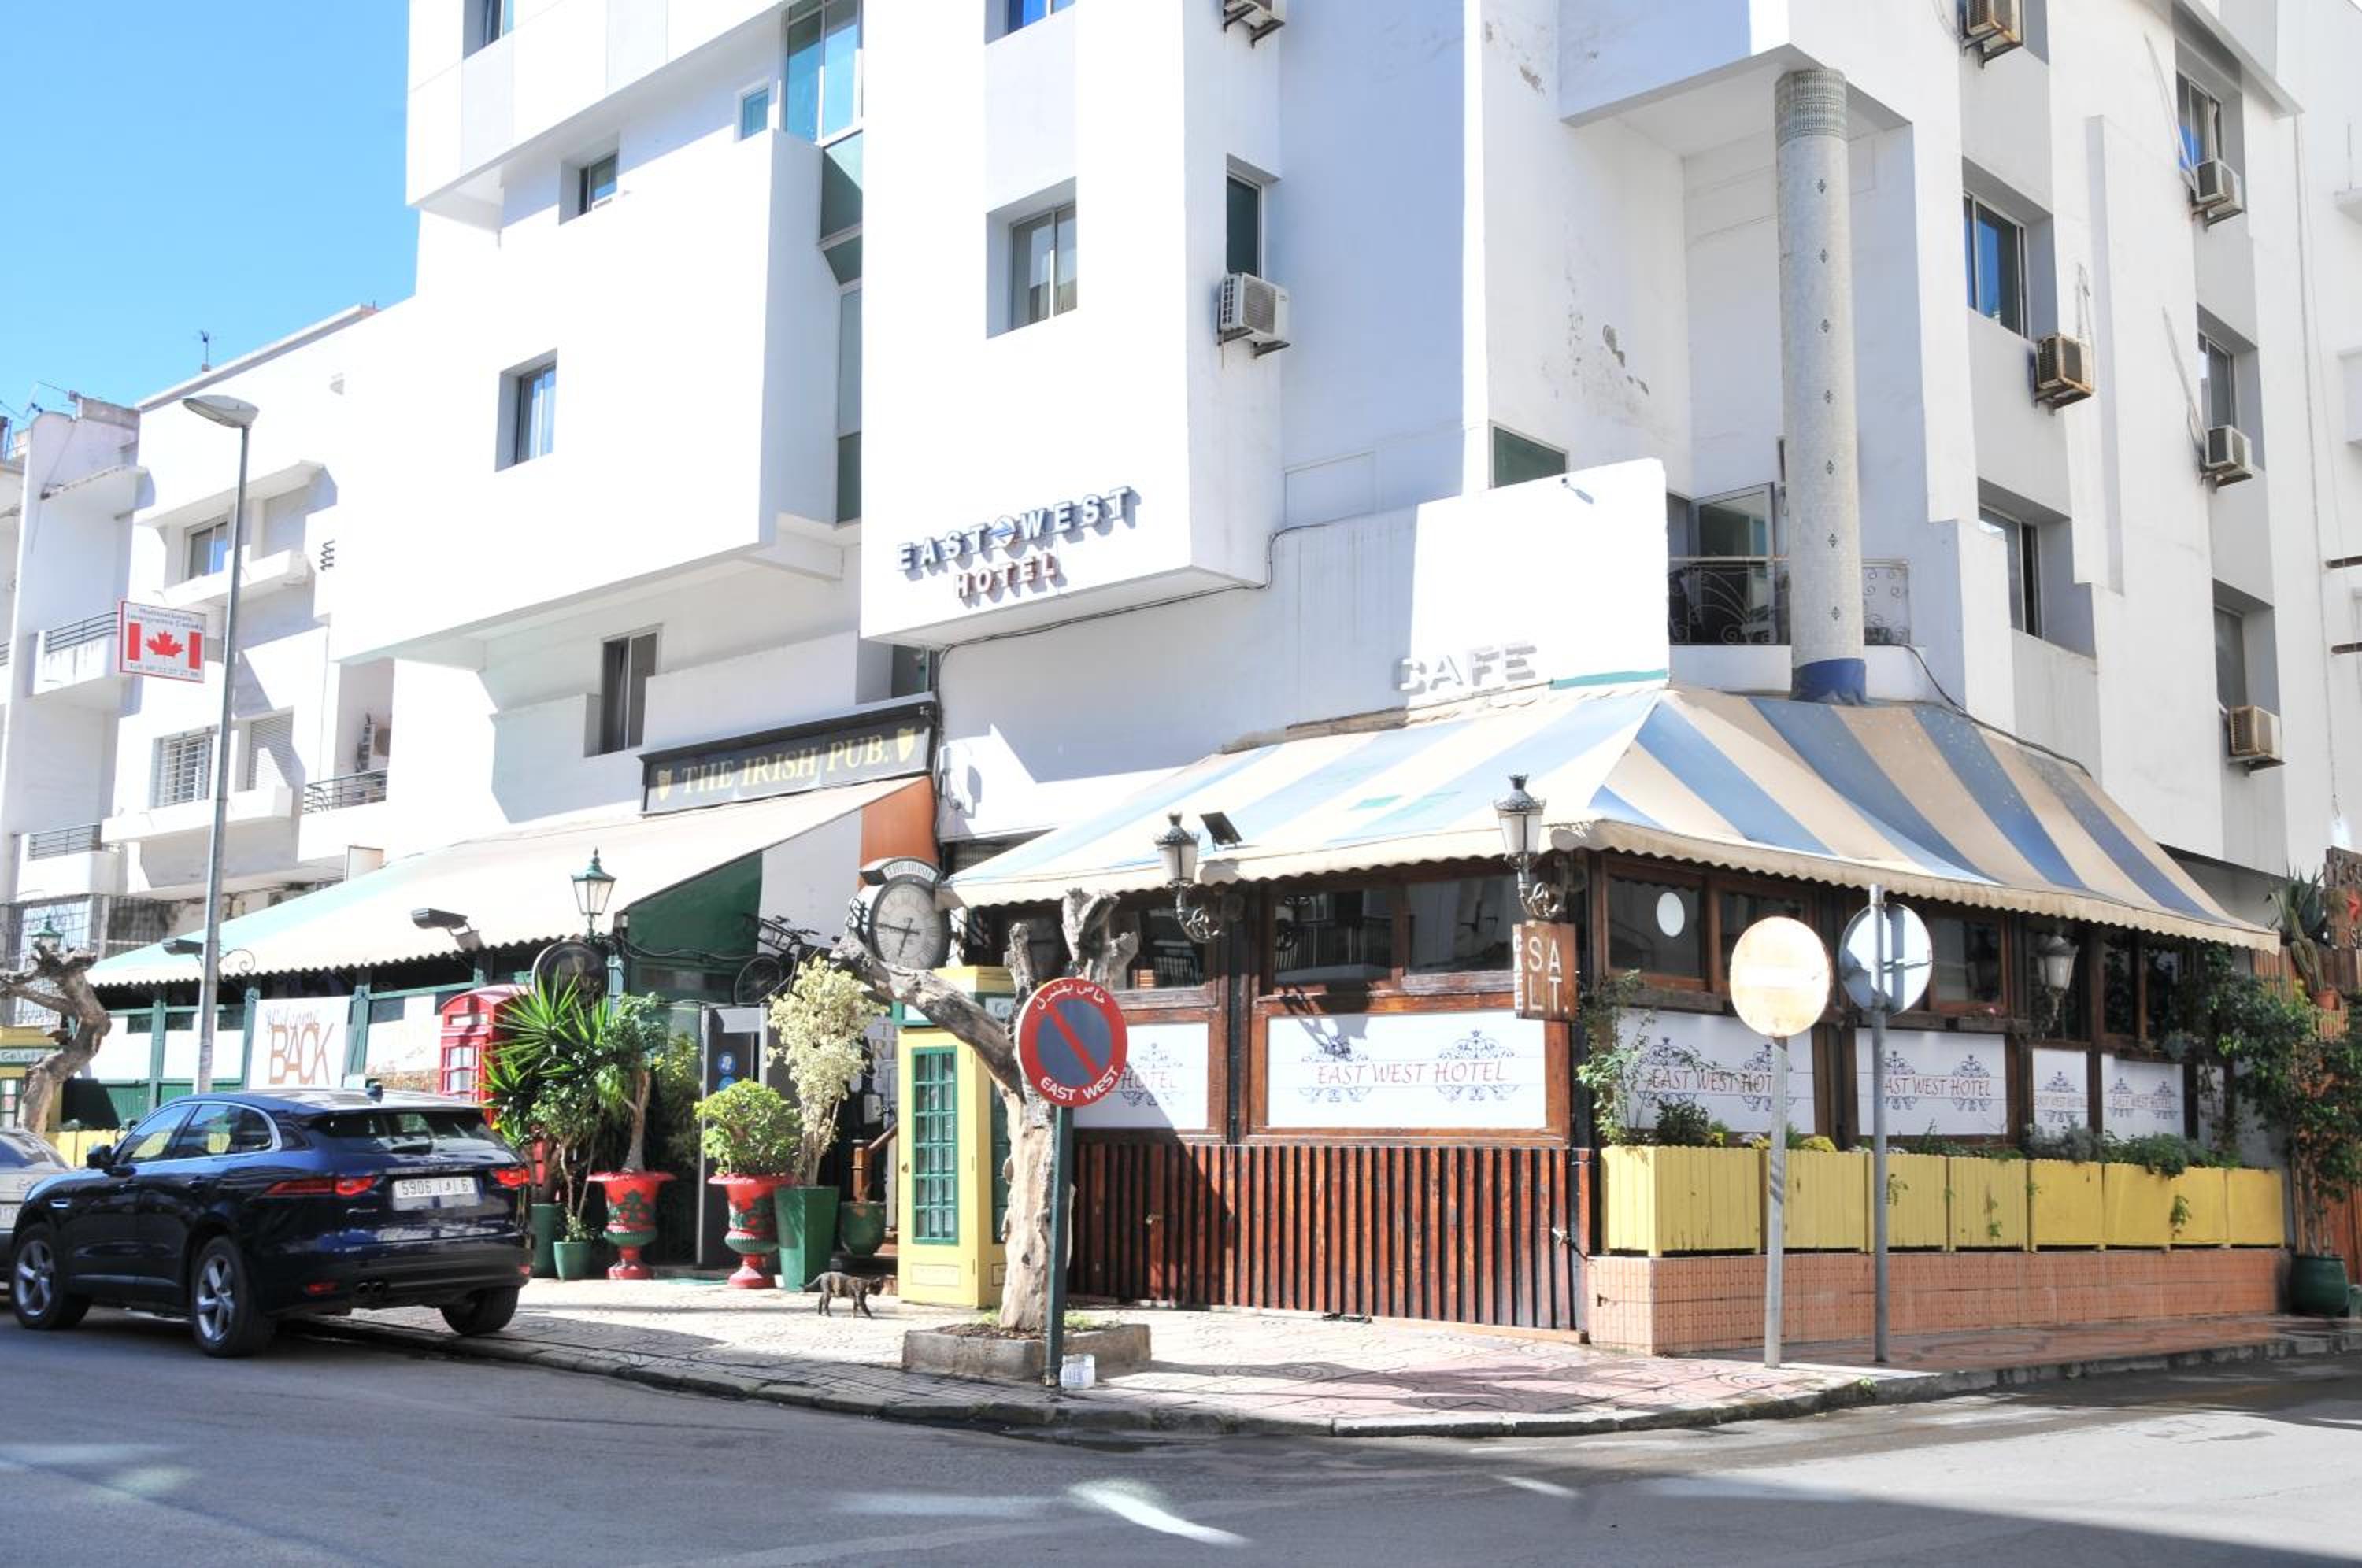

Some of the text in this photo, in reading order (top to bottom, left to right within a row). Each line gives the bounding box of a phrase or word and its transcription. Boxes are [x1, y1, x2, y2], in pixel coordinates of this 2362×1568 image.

[896, 486, 1134, 572] EAST WEST
[955, 553, 1057, 600] HOTEL
[1393, 642, 1537, 695] CAFE
[682, 734, 890, 794] THE IRISH PUB.
[1076, 984, 1105, 1004] خاص
[268, 1022, 335, 1085] BACK
[1317, 1060, 1512, 1085] EAST WEST HOTEL
[1040, 1065, 1119, 1100] EAST WEST
[1651, 1068, 1692, 1089] EAST
[1694, 1069, 1734, 1092] WEST
[1913, 1076, 1946, 1096] WEST
[1951, 1078, 1991, 1096] HOTEL
